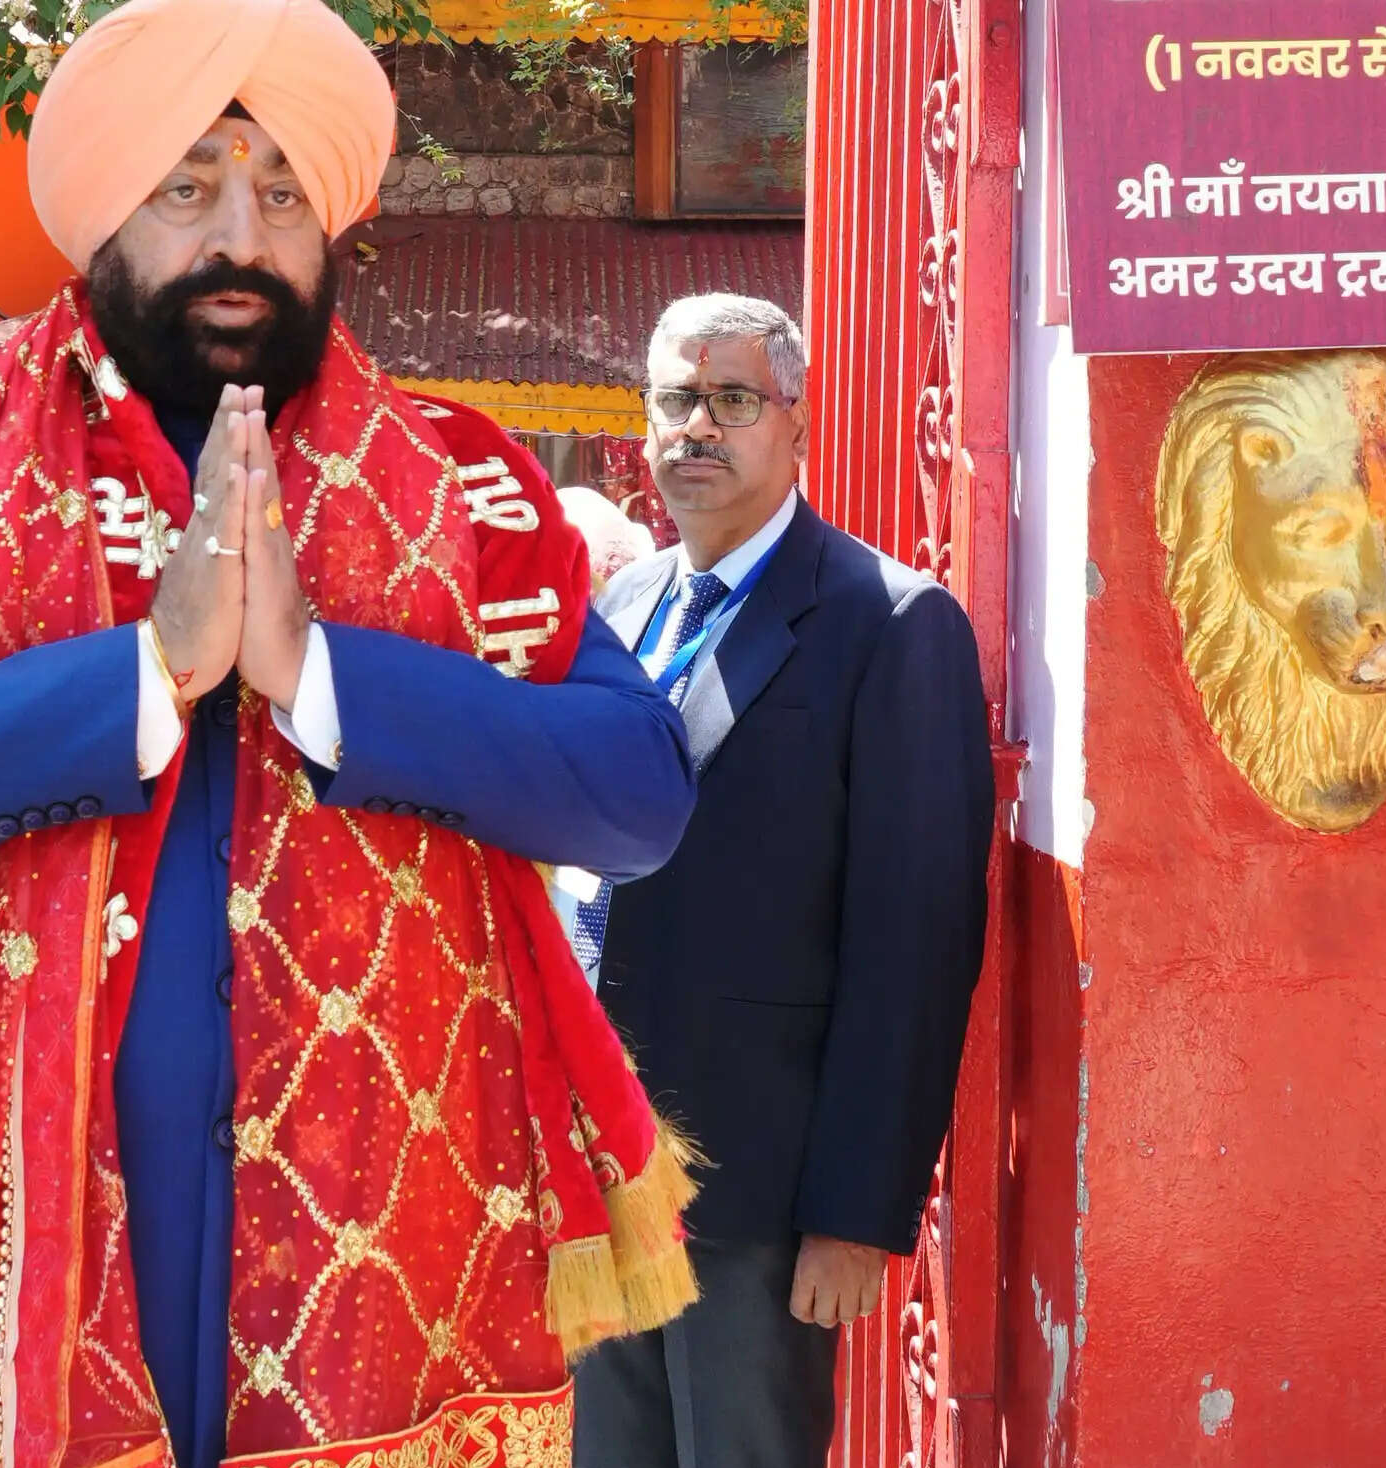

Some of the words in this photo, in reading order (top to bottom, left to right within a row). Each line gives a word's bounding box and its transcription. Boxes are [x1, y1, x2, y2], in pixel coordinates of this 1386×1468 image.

[1145, 33, 1182, 92] (1
[1191, 39, 1350, 81] नवम्बर
[1115, 162, 1174, 220] श्री
[1183, 157, 1245, 217] माँ
[1108, 256, 1218, 298] अमर
[1229, 253, 1325, 296] उदय
